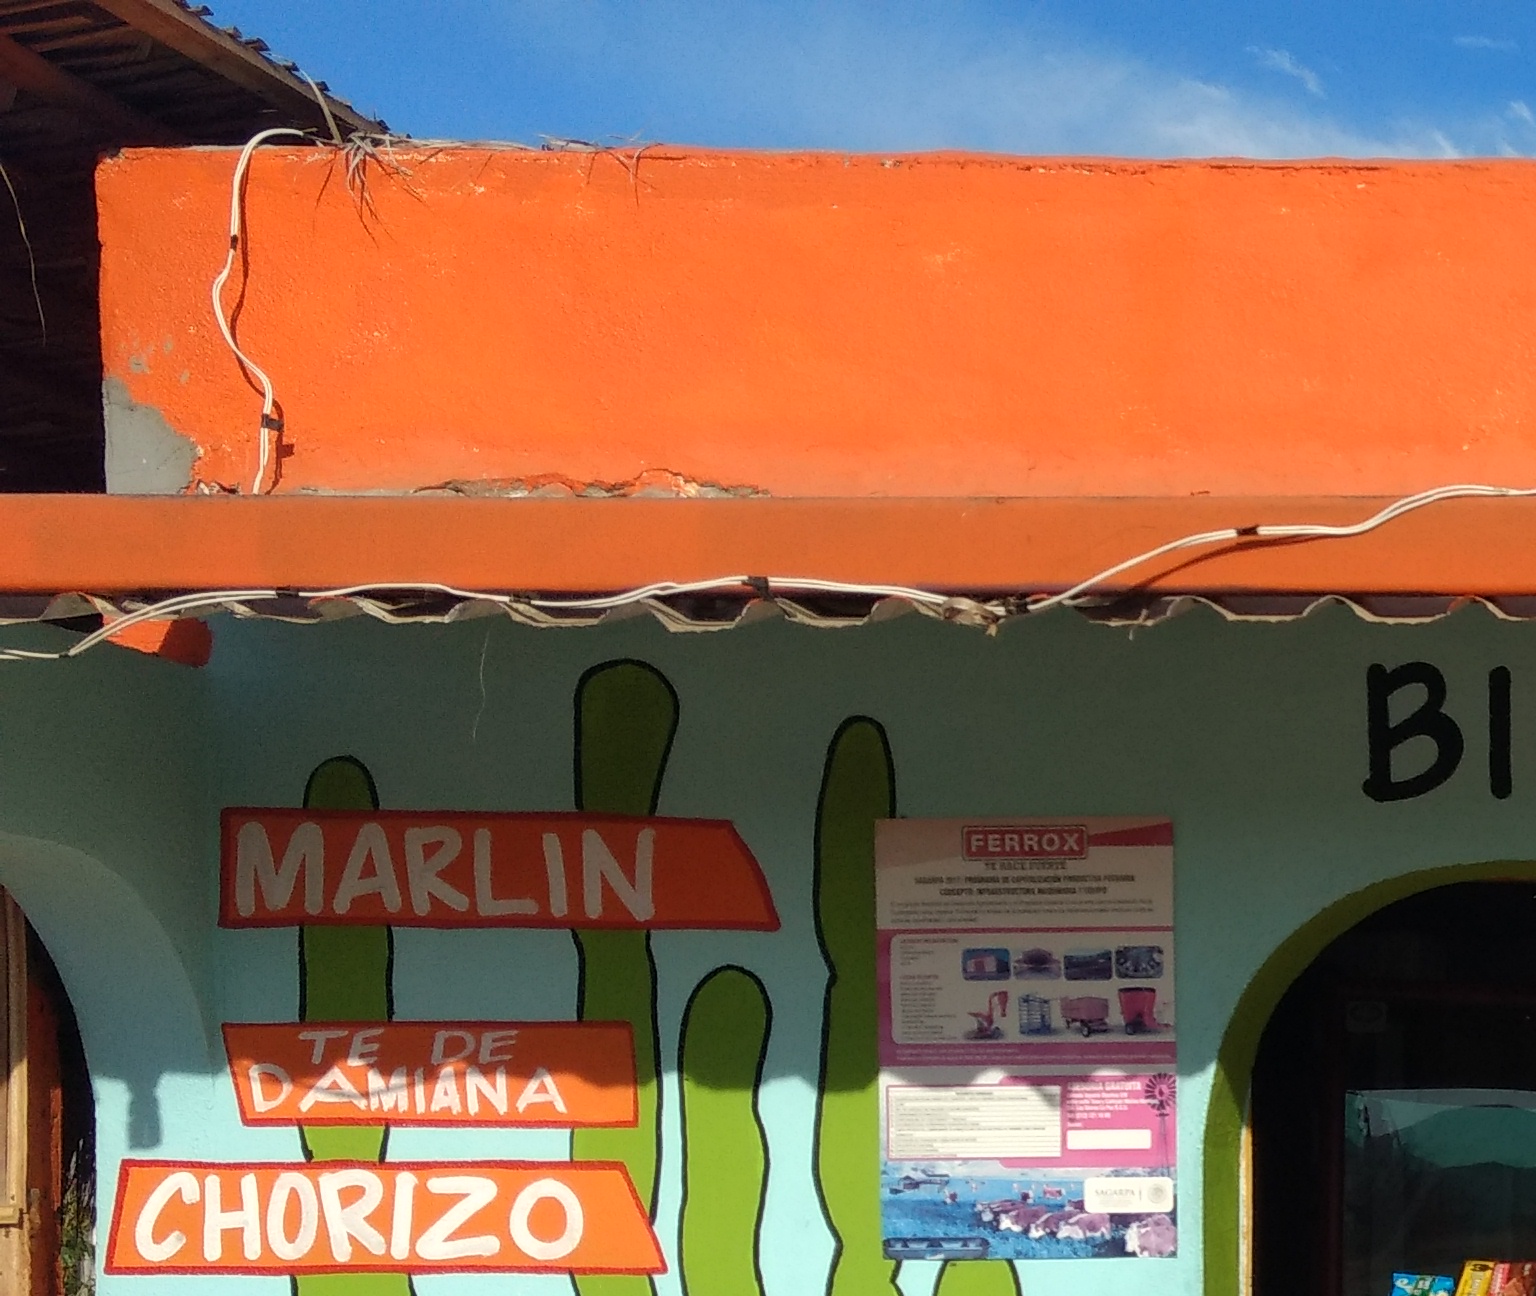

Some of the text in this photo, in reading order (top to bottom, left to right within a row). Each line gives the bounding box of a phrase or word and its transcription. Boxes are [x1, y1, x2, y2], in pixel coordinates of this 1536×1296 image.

[970, 833, 1080, 853] FERROX
[235, 820, 656, 922] MARLIN
[298, 1029, 519, 1067] TE DE
[248, 1062, 568, 1116] DAMIANA
[135, 1169, 584, 1262] CHORIZO
